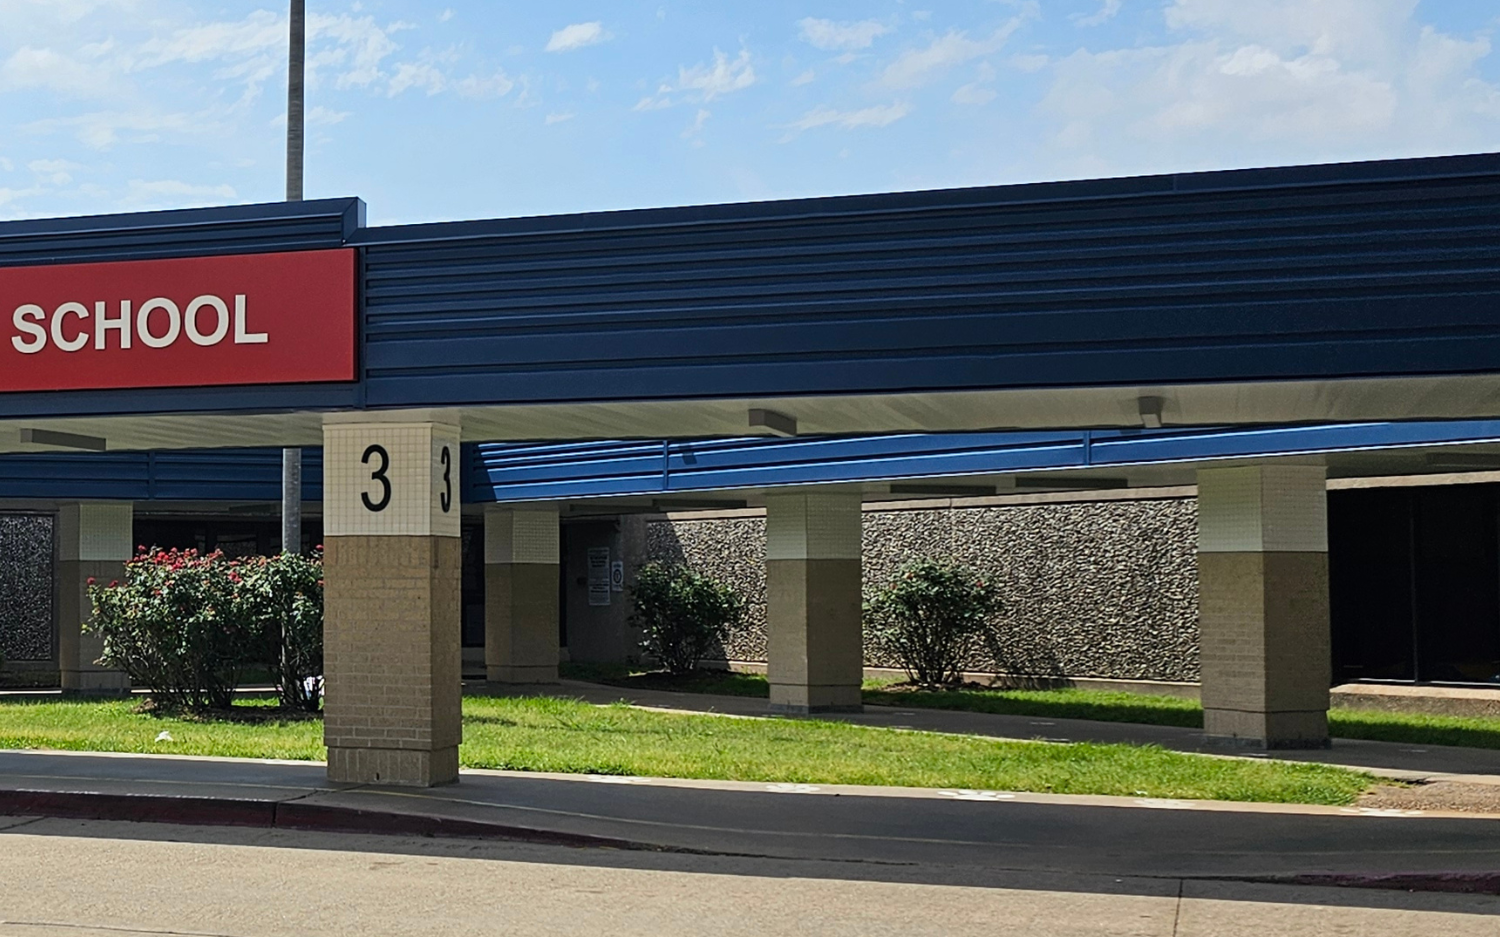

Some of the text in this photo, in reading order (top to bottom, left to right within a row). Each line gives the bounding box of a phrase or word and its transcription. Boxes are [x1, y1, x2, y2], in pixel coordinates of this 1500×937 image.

[11, 294, 269, 354] SCHOOL
[360, 443, 392, 513] 3
[440, 446, 452, 513] 3
